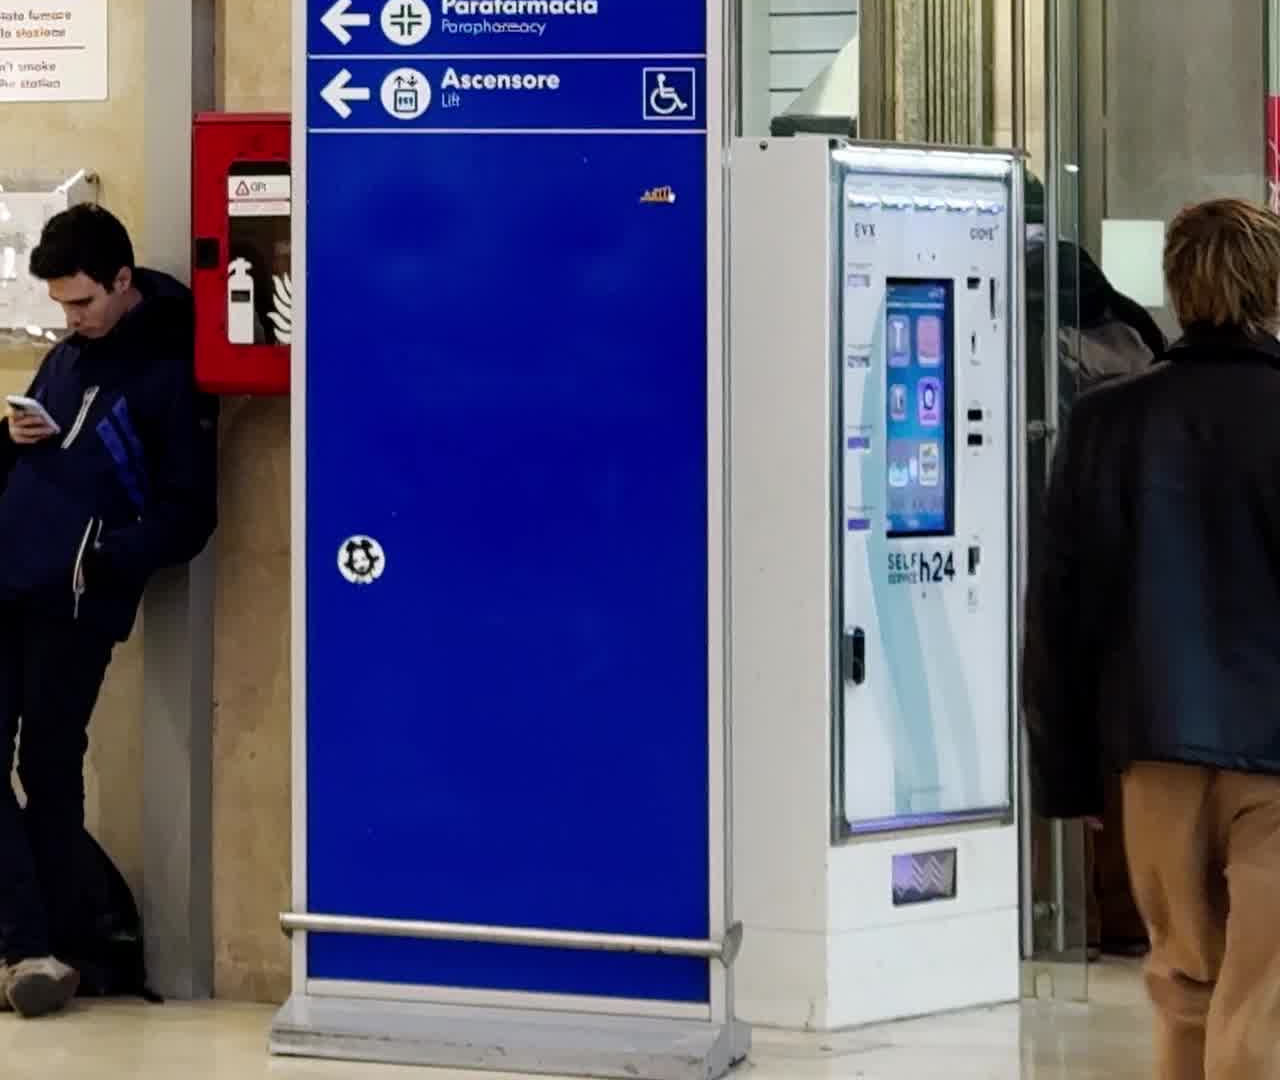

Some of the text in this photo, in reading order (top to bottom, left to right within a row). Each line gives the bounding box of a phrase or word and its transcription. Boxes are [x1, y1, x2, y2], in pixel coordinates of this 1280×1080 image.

[441, 67, 560, 91] Ascensore
[441, 93, 460, 108] Lift
[887, 550, 956, 582] SELF h24
